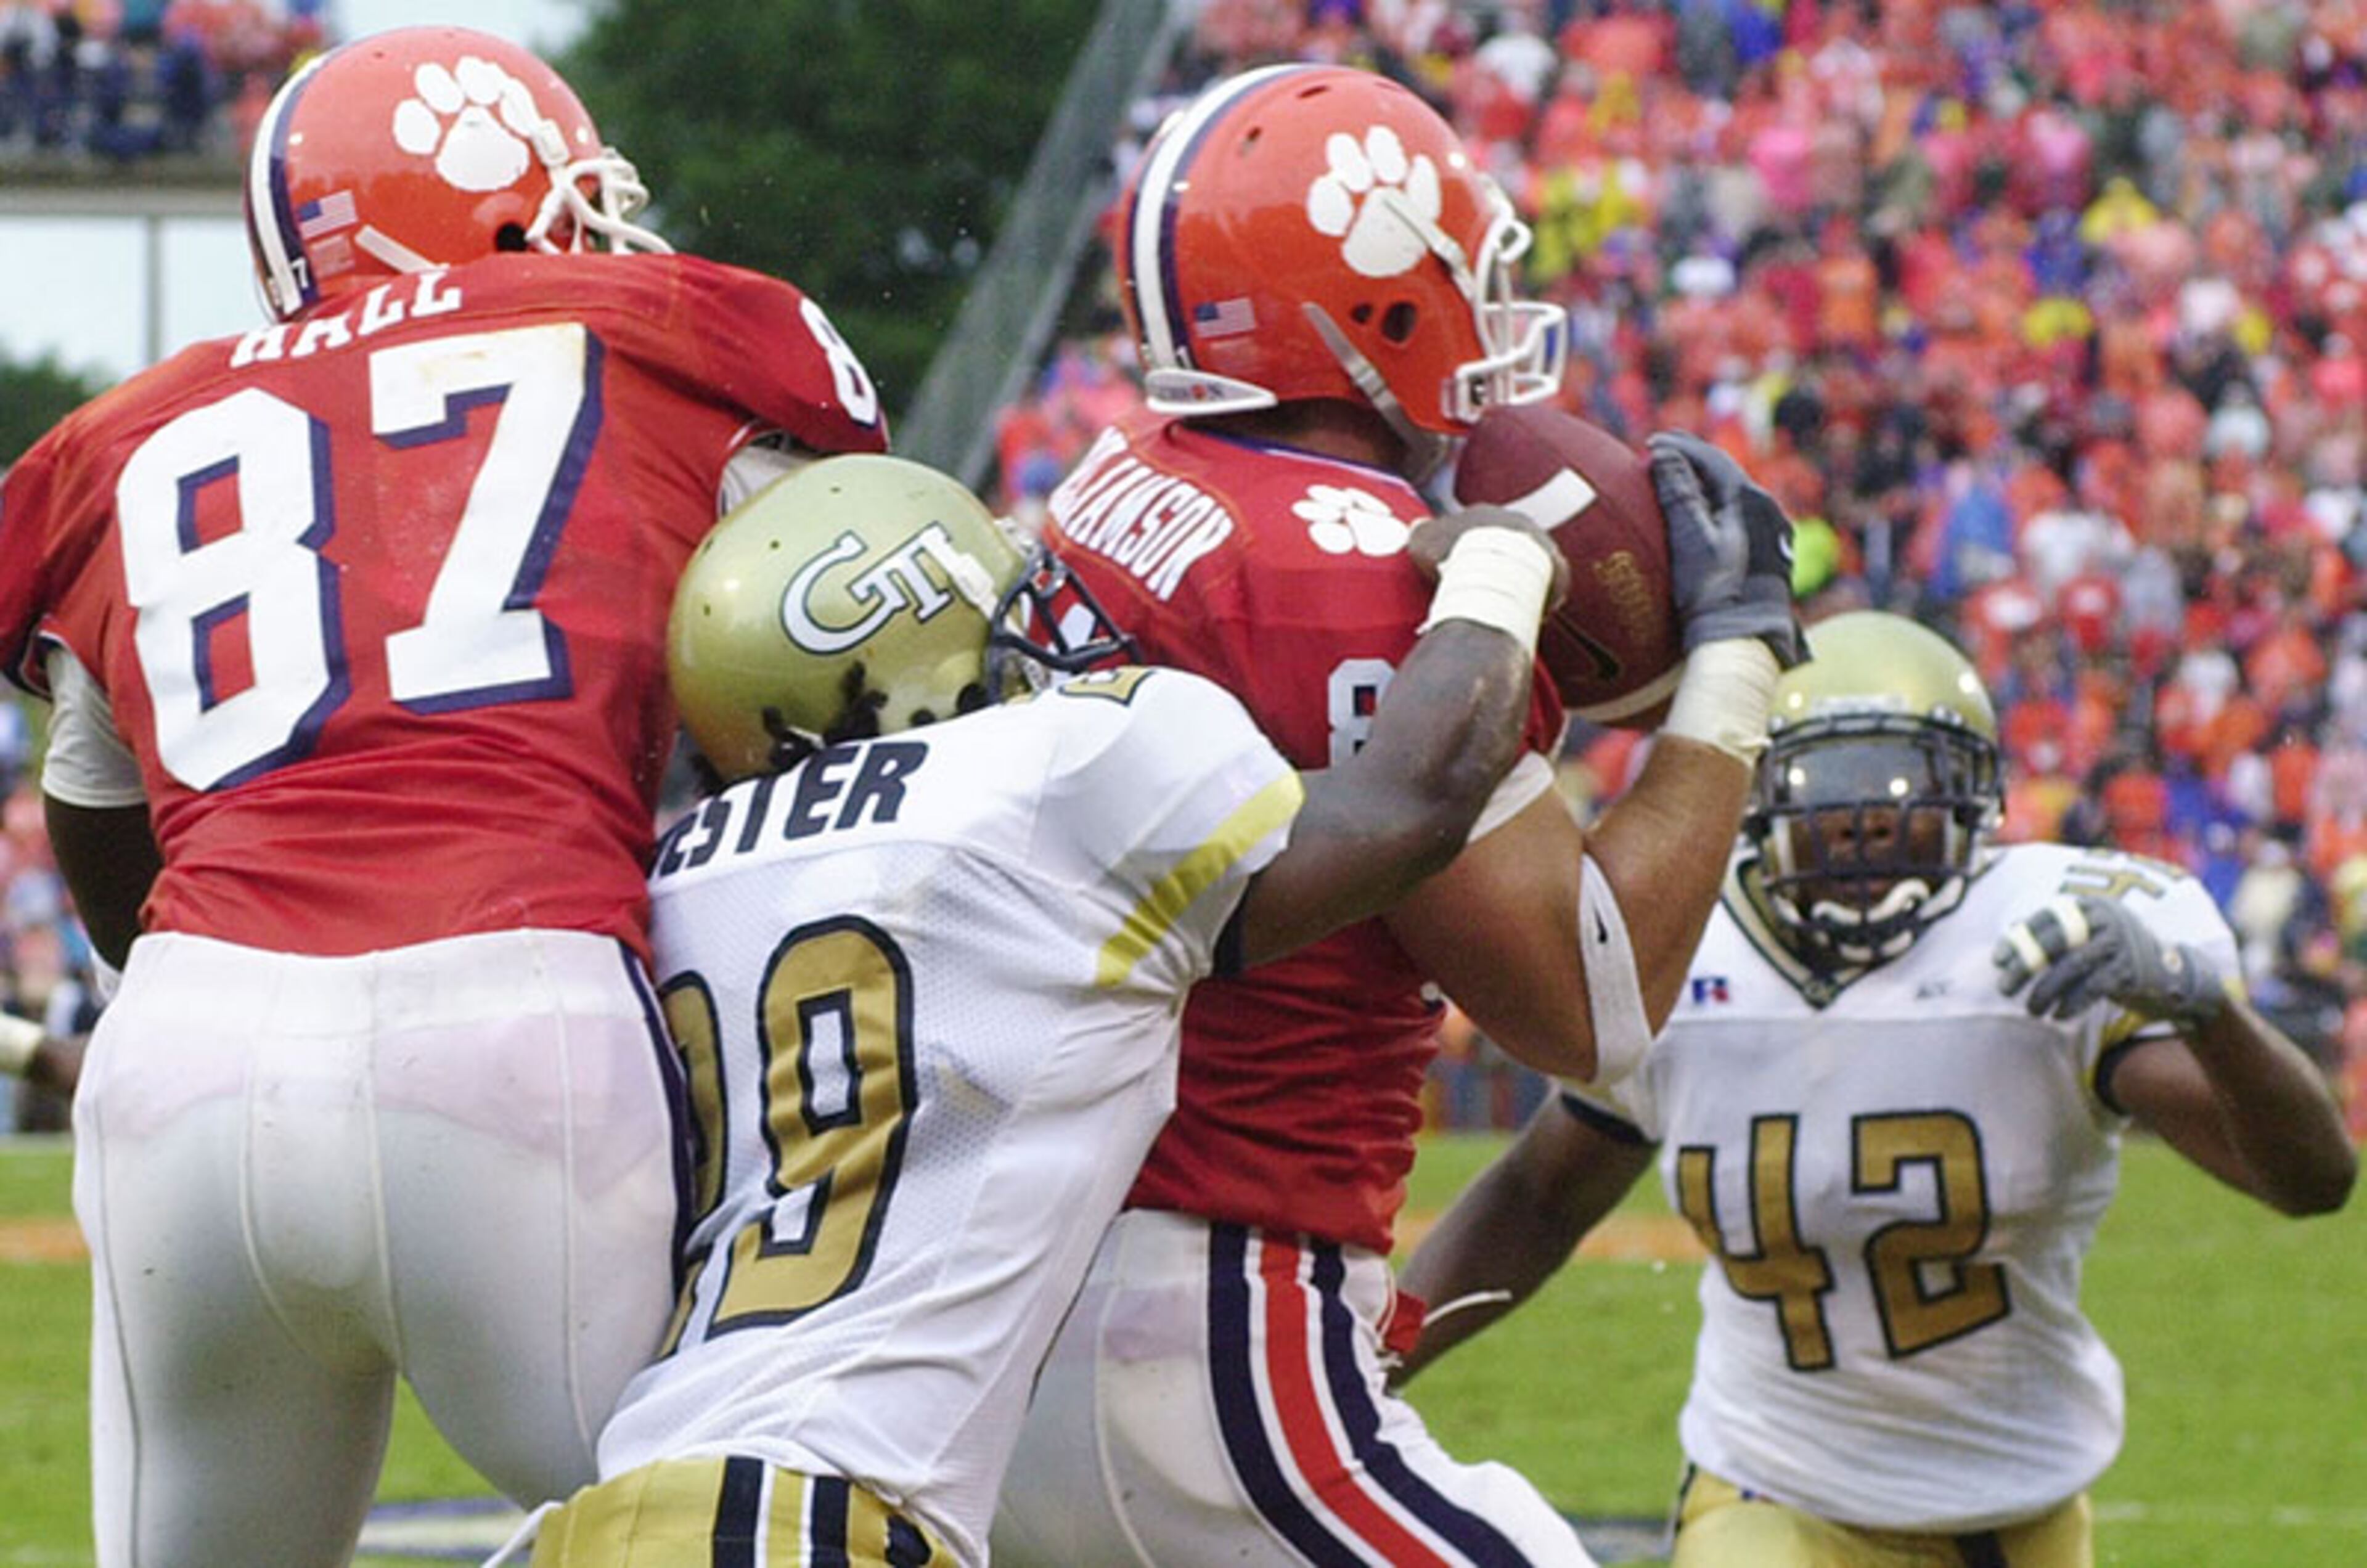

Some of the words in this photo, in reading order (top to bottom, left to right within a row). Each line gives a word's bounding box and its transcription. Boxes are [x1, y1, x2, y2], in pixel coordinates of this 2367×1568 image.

[230, 263, 461, 368] HALL
[117, 322, 605, 793] 87
[779, 520, 955, 655] GT
[647, 741, 930, 879] ESTER
[1676, 1108, 2013, 1373] 42
